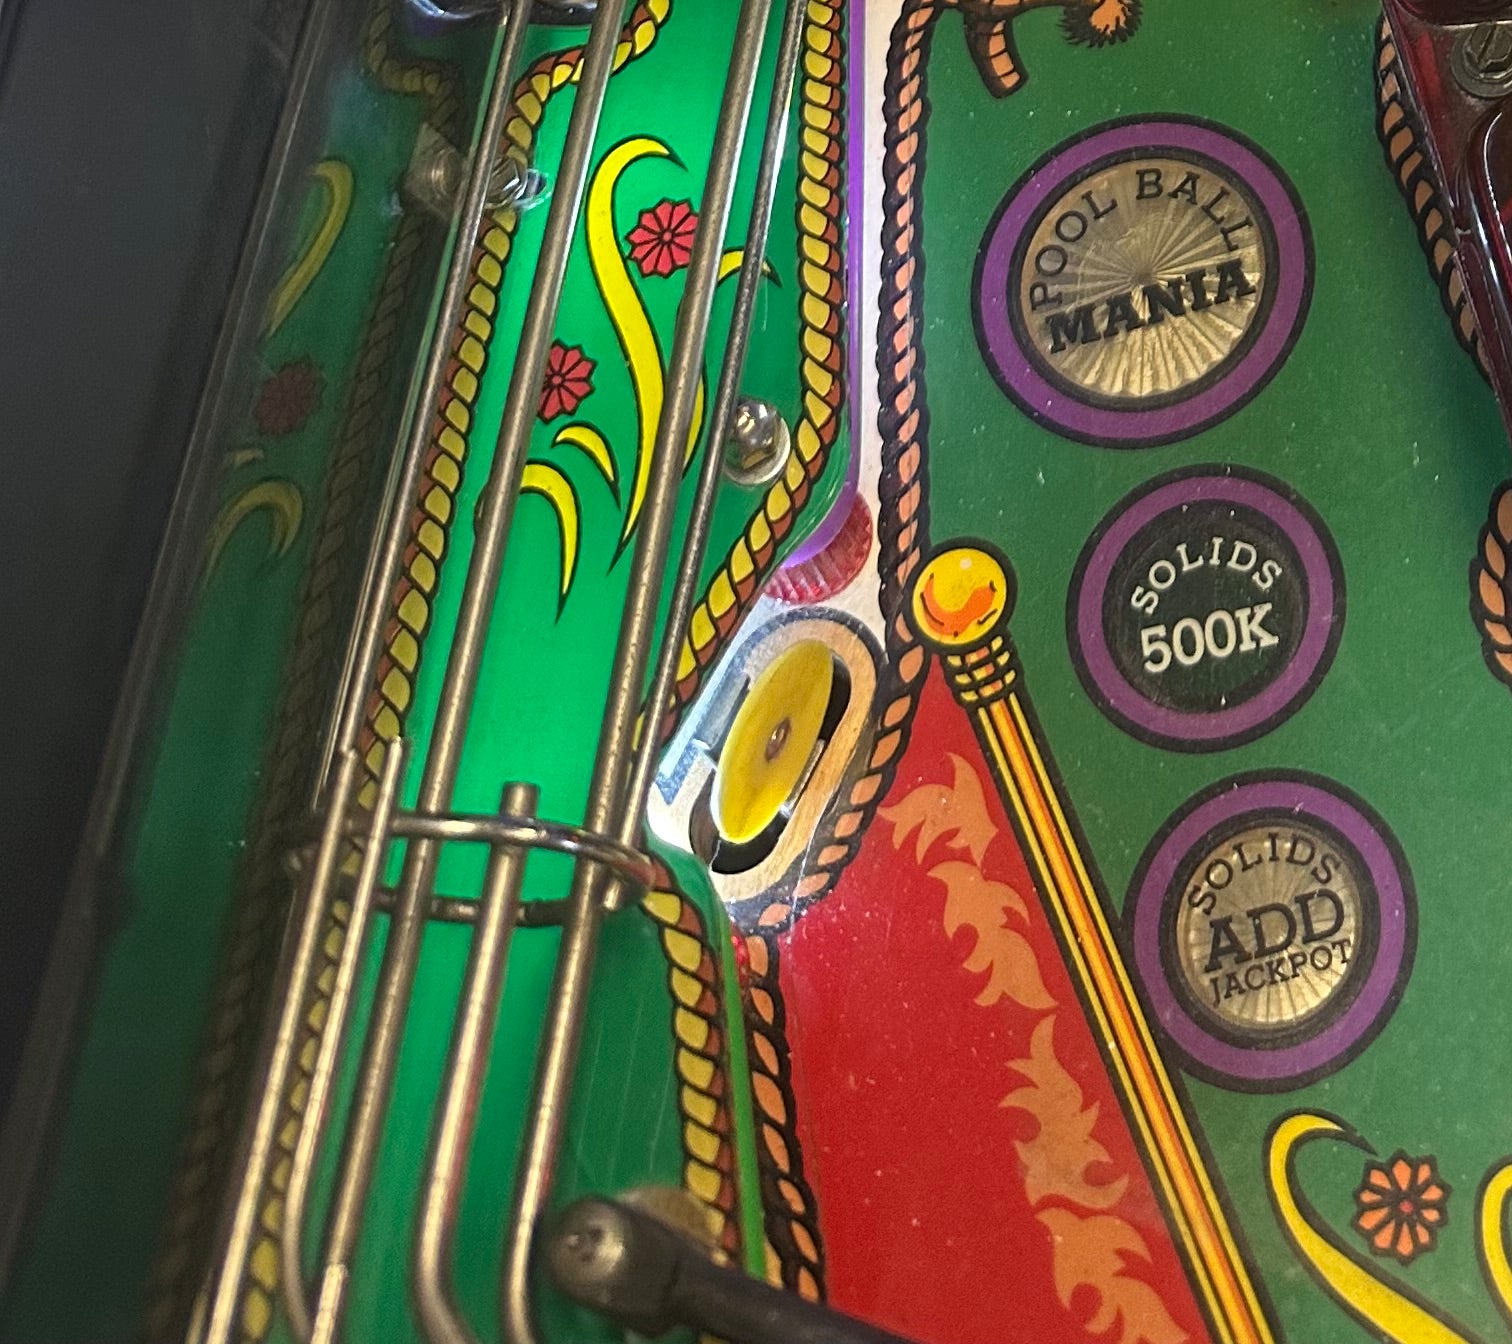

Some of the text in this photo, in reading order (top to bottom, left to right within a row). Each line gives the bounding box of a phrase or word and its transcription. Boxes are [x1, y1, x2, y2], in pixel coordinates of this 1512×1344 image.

[1030, 167, 1254, 311] POOL BALL
[1045, 258, 1256, 354] MANIA
[1130, 536, 1282, 615] SOLIDS
[1140, 602, 1280, 673] 500K
[1188, 833, 1341, 915] SOLIDS
[1203, 888, 1345, 973] ADD
[1208, 937, 1351, 1009] JACKPOT
